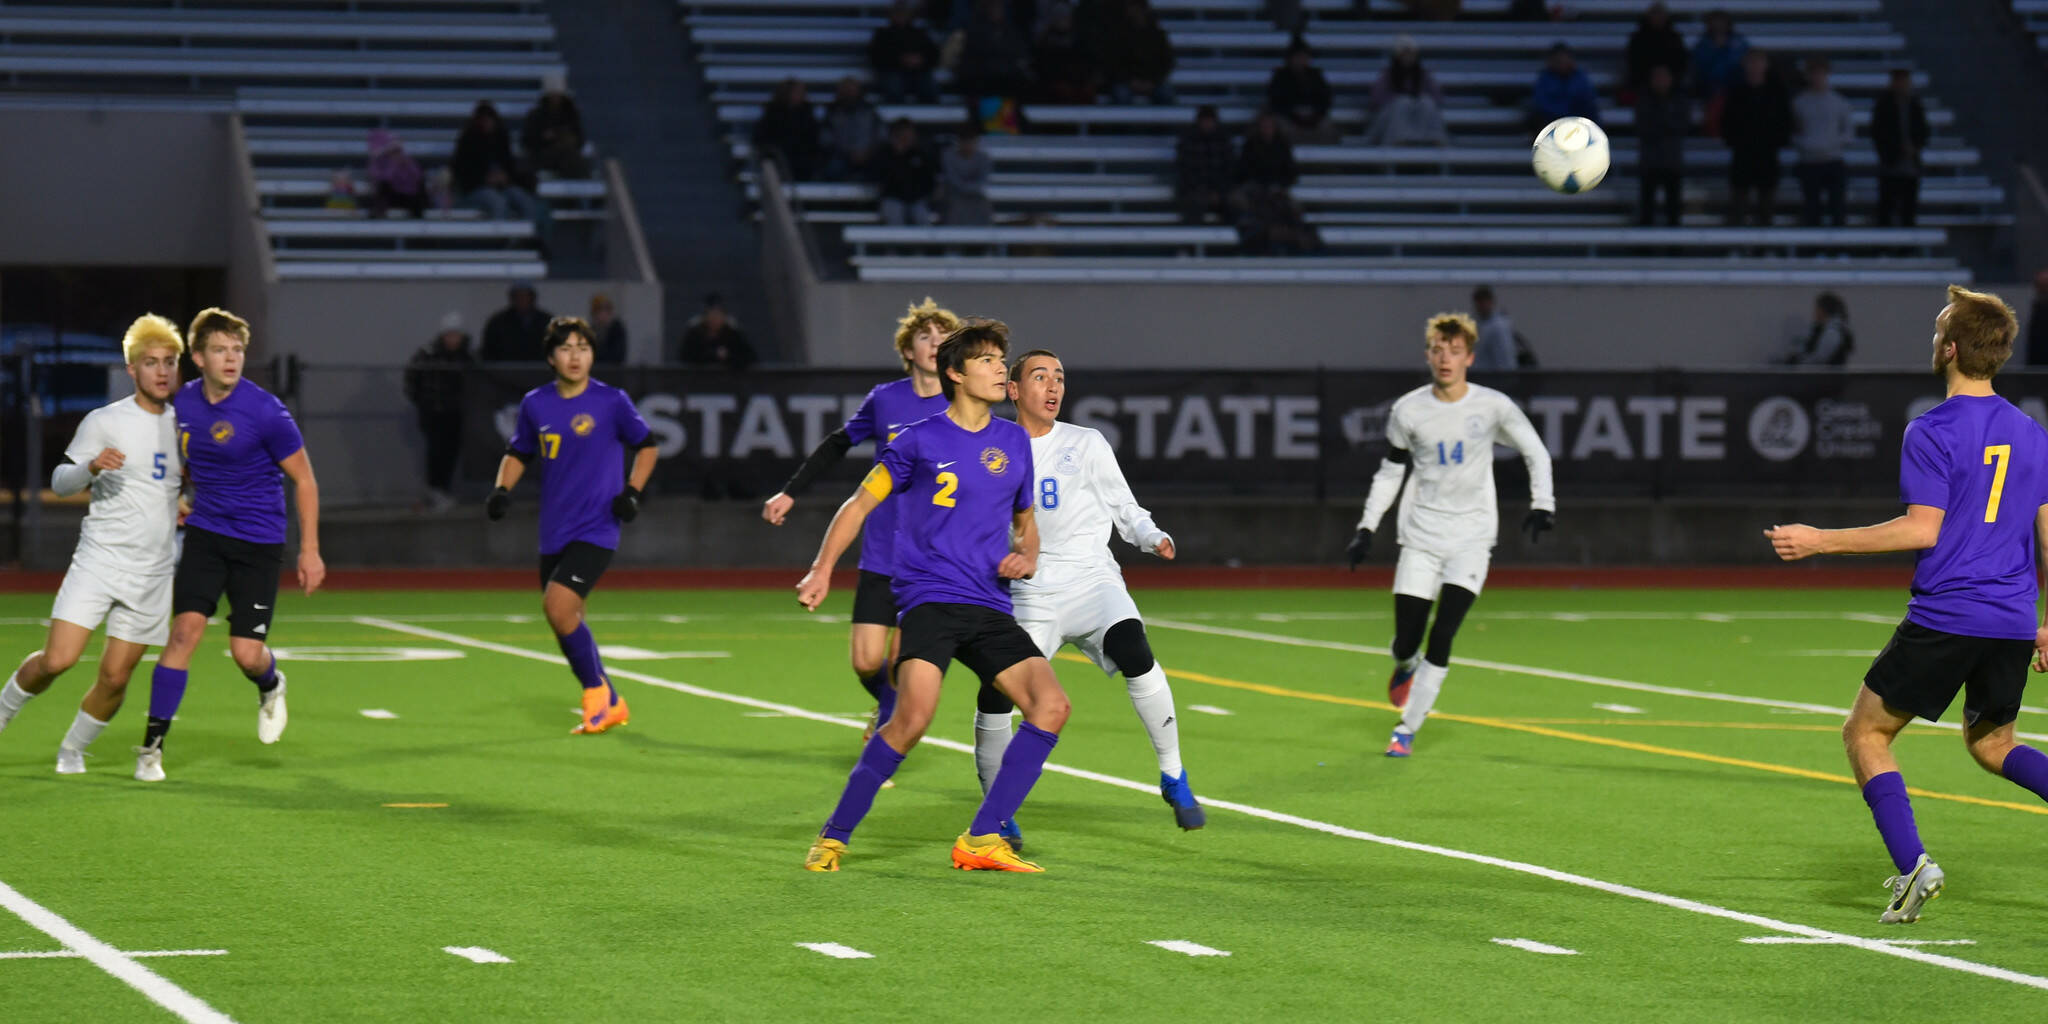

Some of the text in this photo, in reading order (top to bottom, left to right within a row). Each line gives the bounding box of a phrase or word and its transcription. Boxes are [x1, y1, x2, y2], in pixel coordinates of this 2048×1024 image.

[1494, 396, 1727, 460] TATE
[539, 433, 562, 459] 17
[1437, 441, 1464, 465] 14
[152, 453, 167, 480] 5
[932, 471, 959, 508] 2
[1984, 445, 2011, 523] 7
